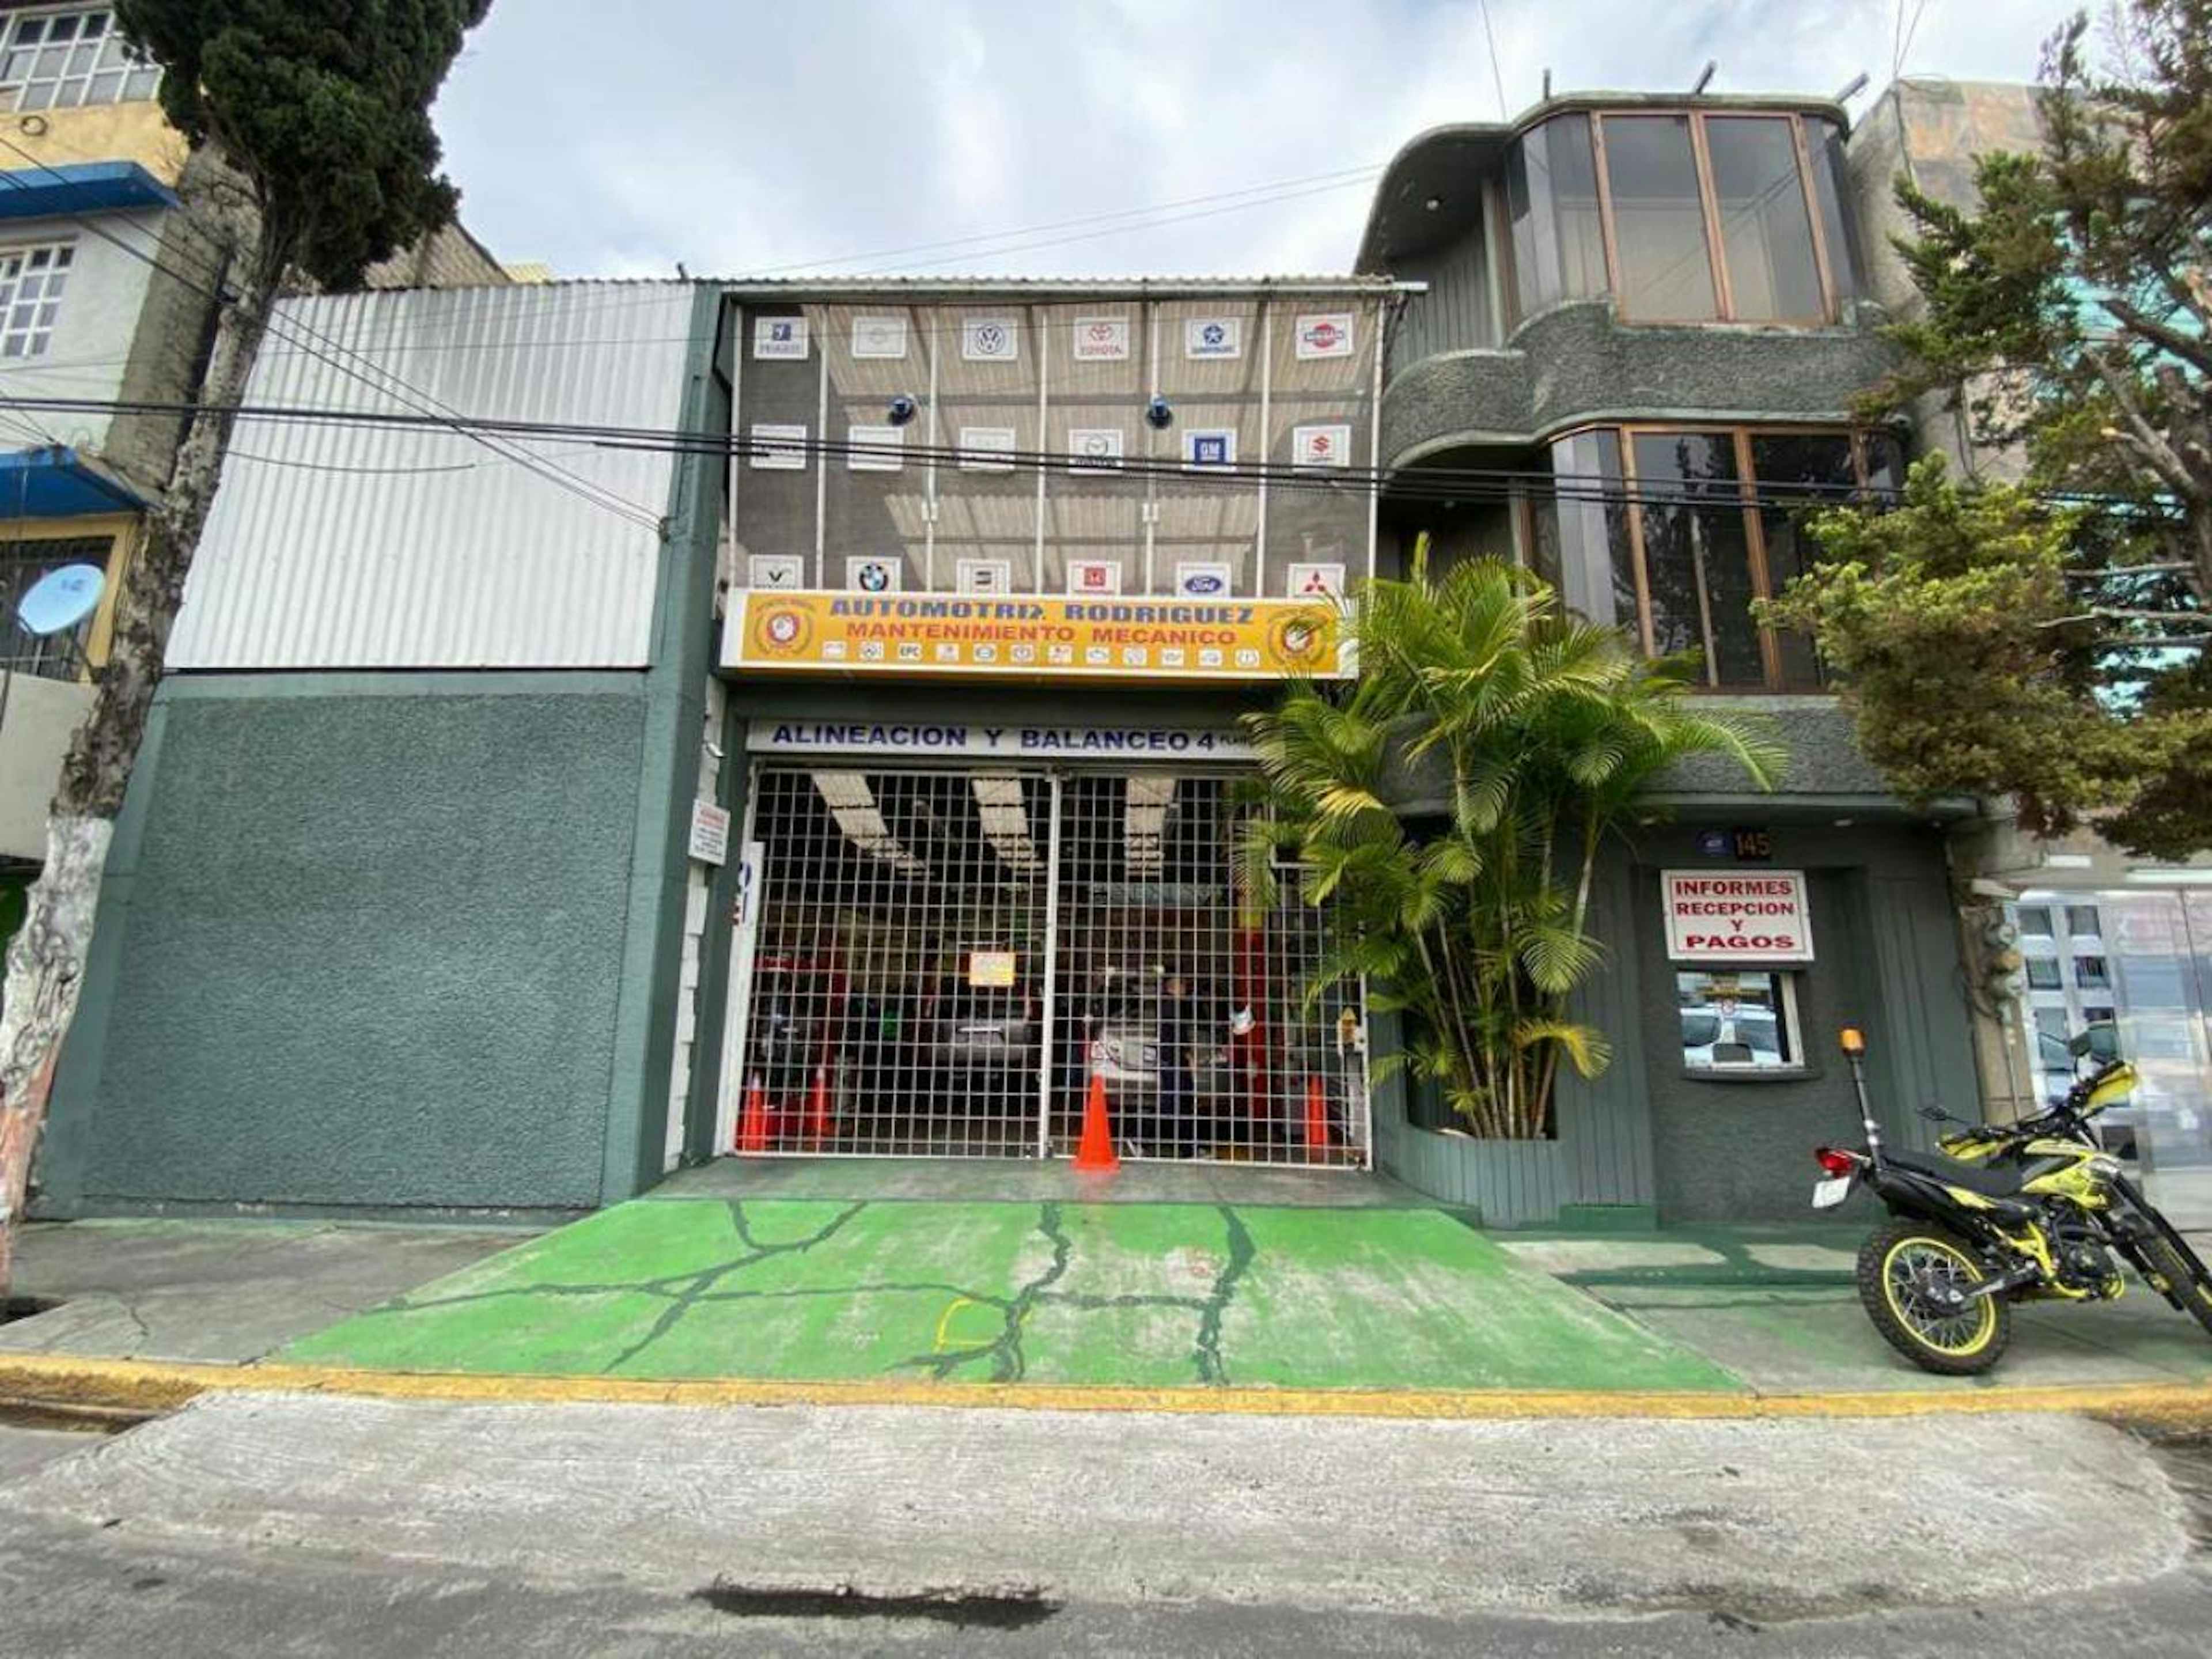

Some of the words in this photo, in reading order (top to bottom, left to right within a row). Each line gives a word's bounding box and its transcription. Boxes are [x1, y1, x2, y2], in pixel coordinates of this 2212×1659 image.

[1065, 604, 1253, 624] RODRIGUEZ
[847, 622, 1074, 642] MANTENIMIENTO
[1092, 627, 1237, 645] MECANICO
[772, 724, 967, 747] ALINEACION
[985, 728, 1003, 747] Y
[1021, 730, 1189, 750] BALANCEO
[1196, 732, 1213, 751] 4
[1734, 833, 1771, 856] 145
[1675, 881, 1793, 895] INFORMES
[1676, 903, 1794, 915] RECEPCION
[1731, 919, 1743, 932] Y
[1686, 935, 1795, 948] PAGOS
